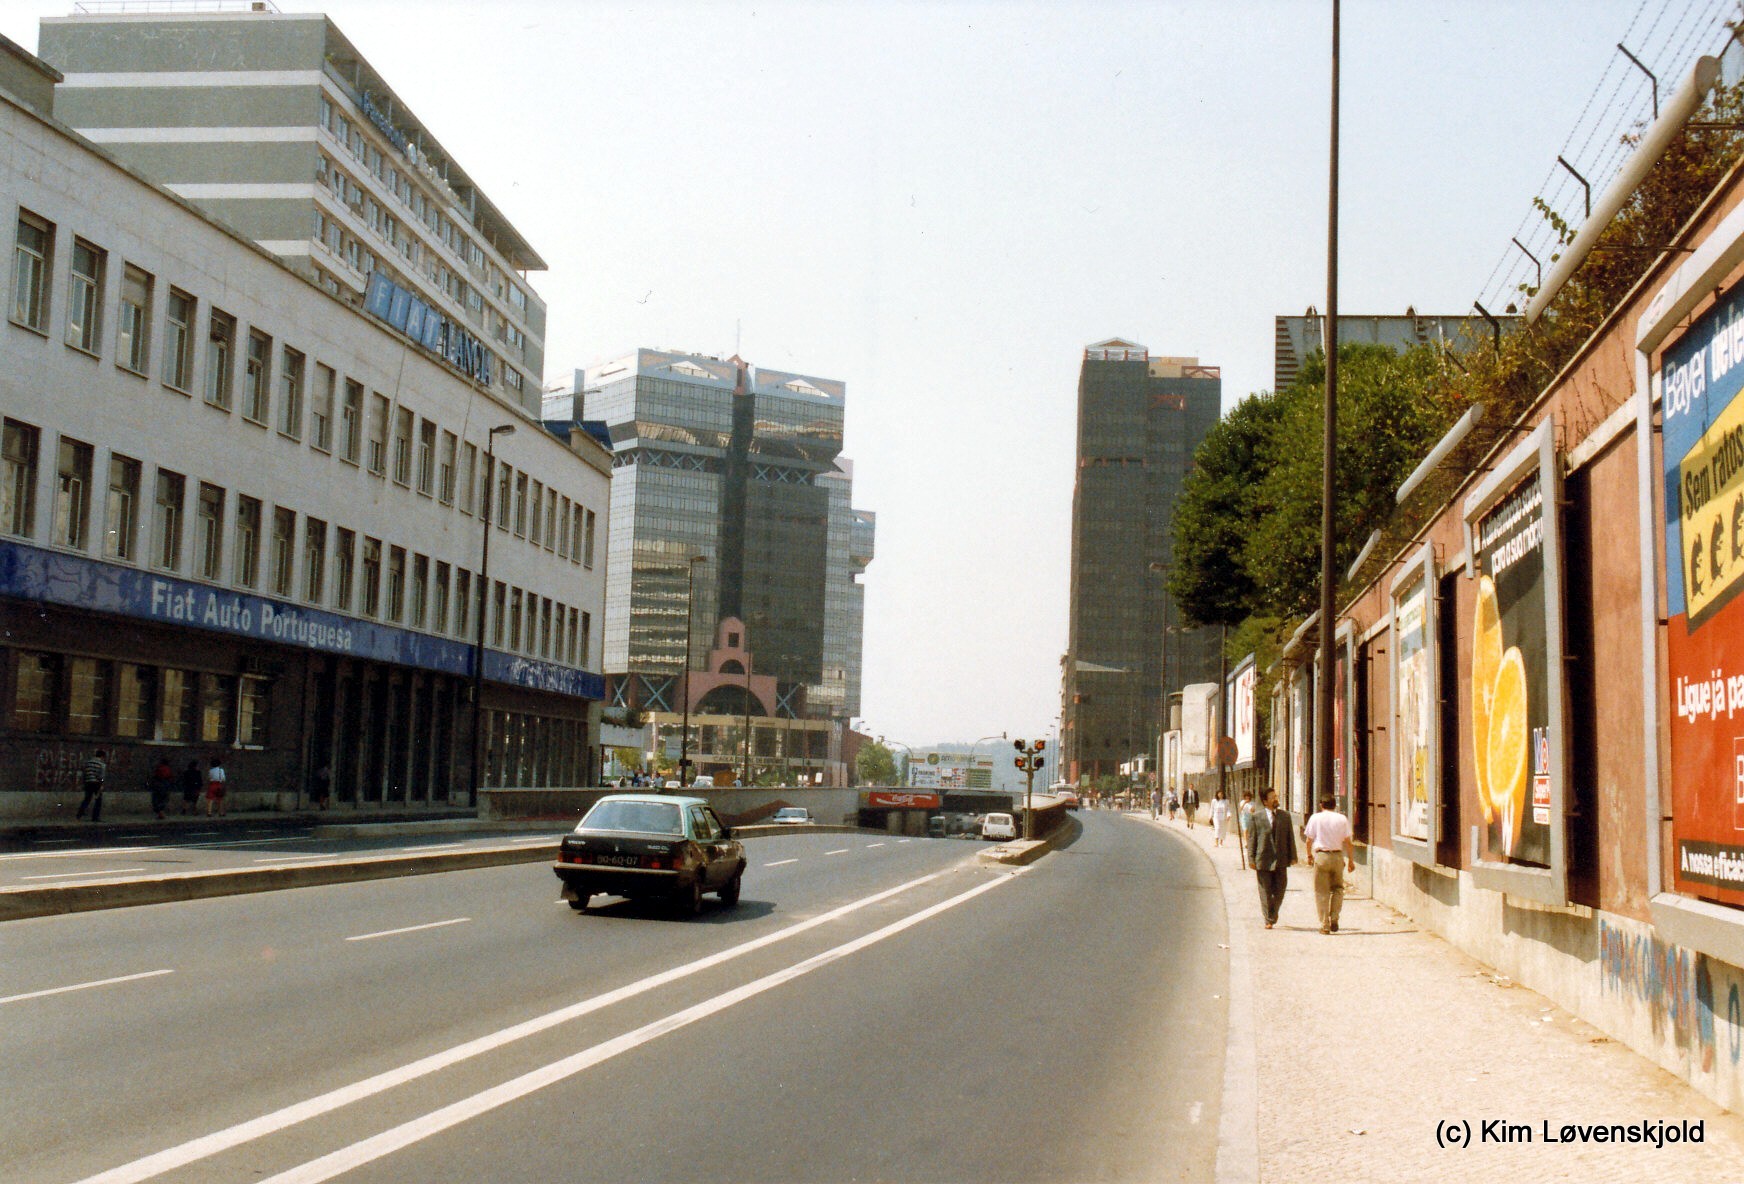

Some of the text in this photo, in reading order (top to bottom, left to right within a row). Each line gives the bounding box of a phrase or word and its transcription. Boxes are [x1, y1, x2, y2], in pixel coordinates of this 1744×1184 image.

[374, 280, 439, 348] FIAT
[1665, 303, 1744, 420] Bayer defe
[1685, 423, 1744, 521] Sem ratos
[151, 579, 353, 650] Fiat Auto Portuguesa
[1676, 668, 1744, 724] Ligue já pa
[1681, 845, 1689, 872] A
[1688, 852, 1713, 877] nossa
